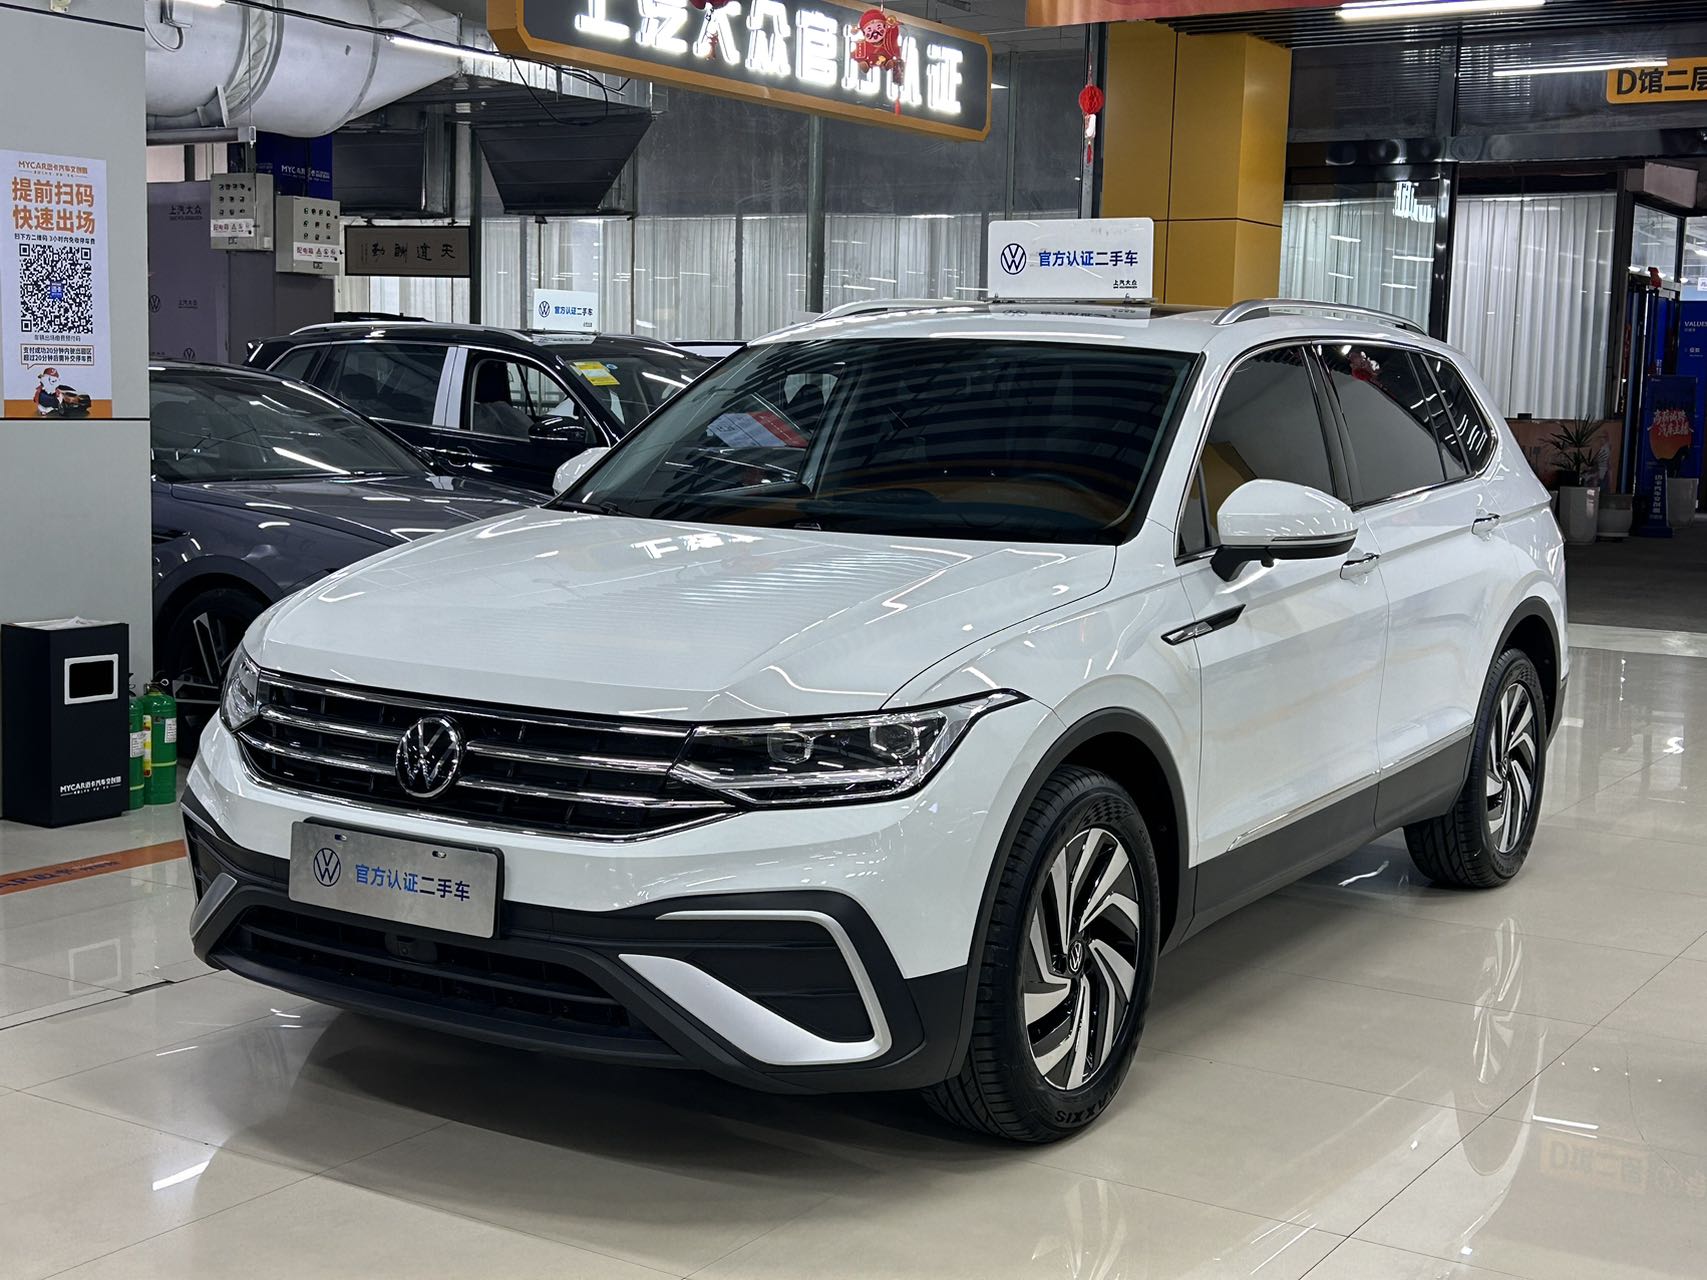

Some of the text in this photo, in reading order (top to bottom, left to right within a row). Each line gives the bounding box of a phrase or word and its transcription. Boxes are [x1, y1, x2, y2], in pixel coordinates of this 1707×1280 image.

[12, 176, 95, 207] 提前扫码
[12, 204, 96, 234] 快速出场
[1038, 249, 1139, 268] 官方认证二手车
[354, 863, 471, 902] 官方认证二手车
